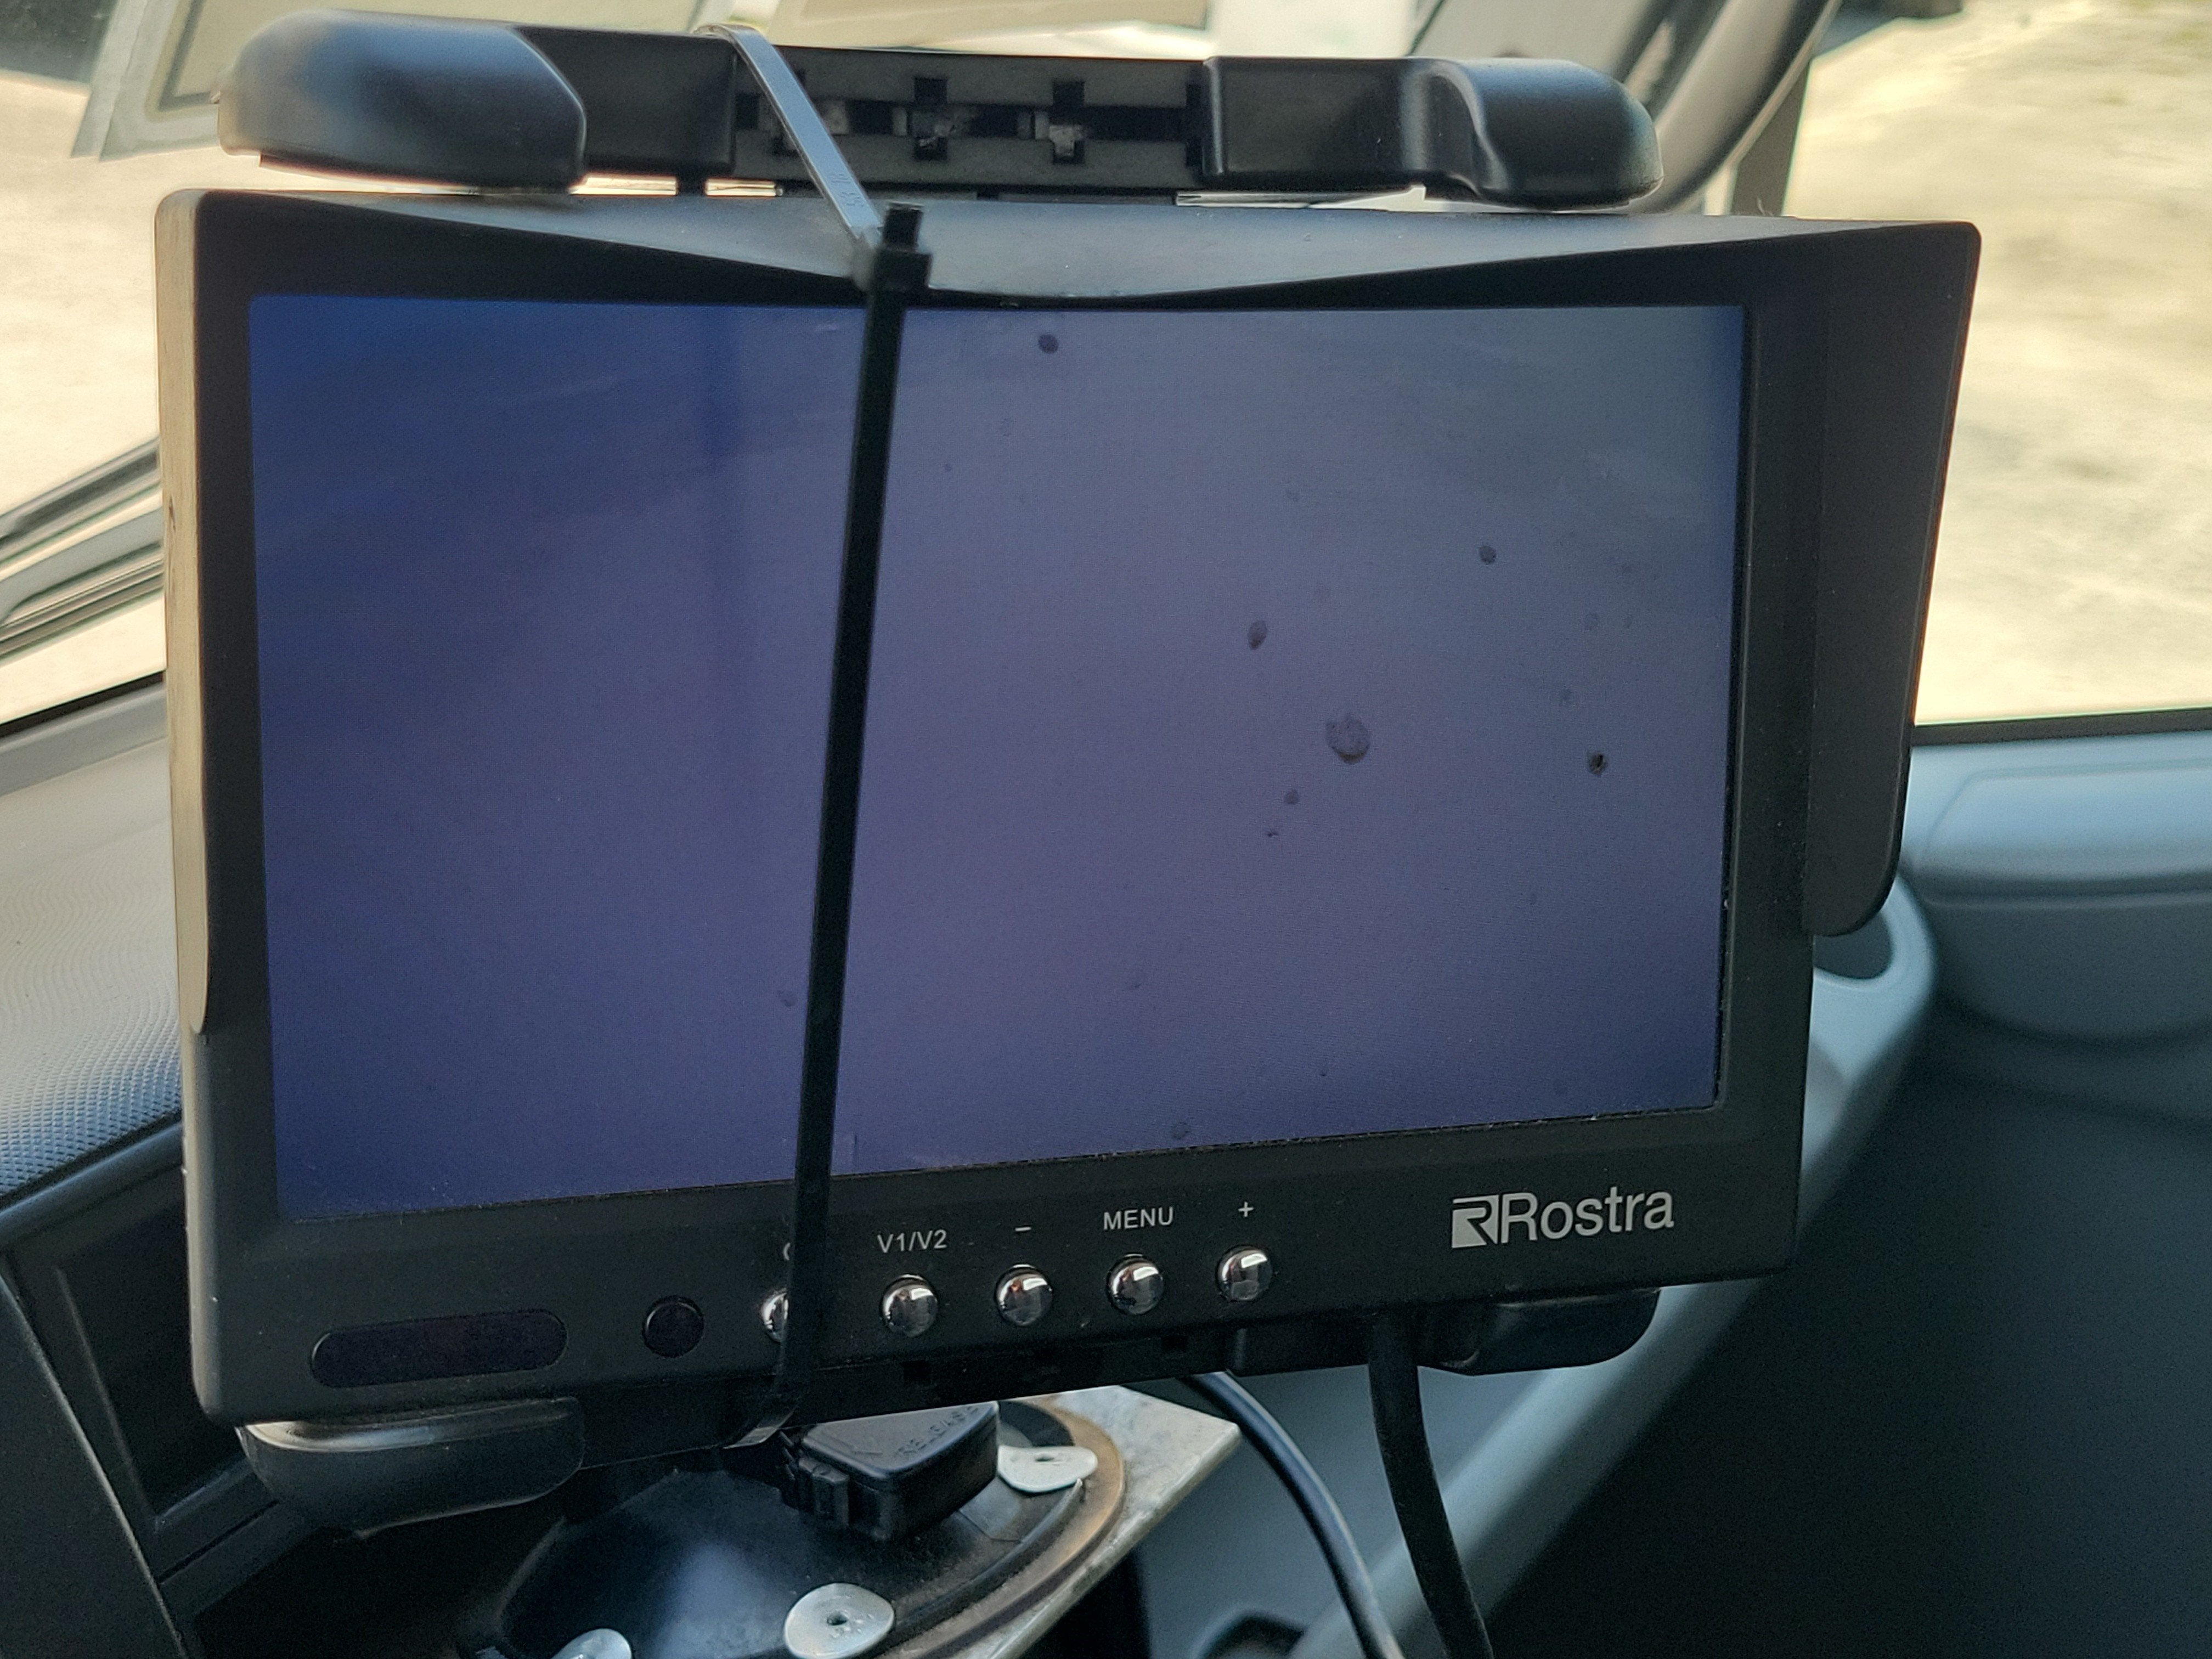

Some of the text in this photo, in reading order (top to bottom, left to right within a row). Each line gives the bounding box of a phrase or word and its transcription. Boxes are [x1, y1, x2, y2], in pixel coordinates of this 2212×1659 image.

[1103, 1206, 1174, 1230] MENU
[1501, 1186, 1674, 1244] Rostra
[877, 1229, 947, 1253] V1/V2
